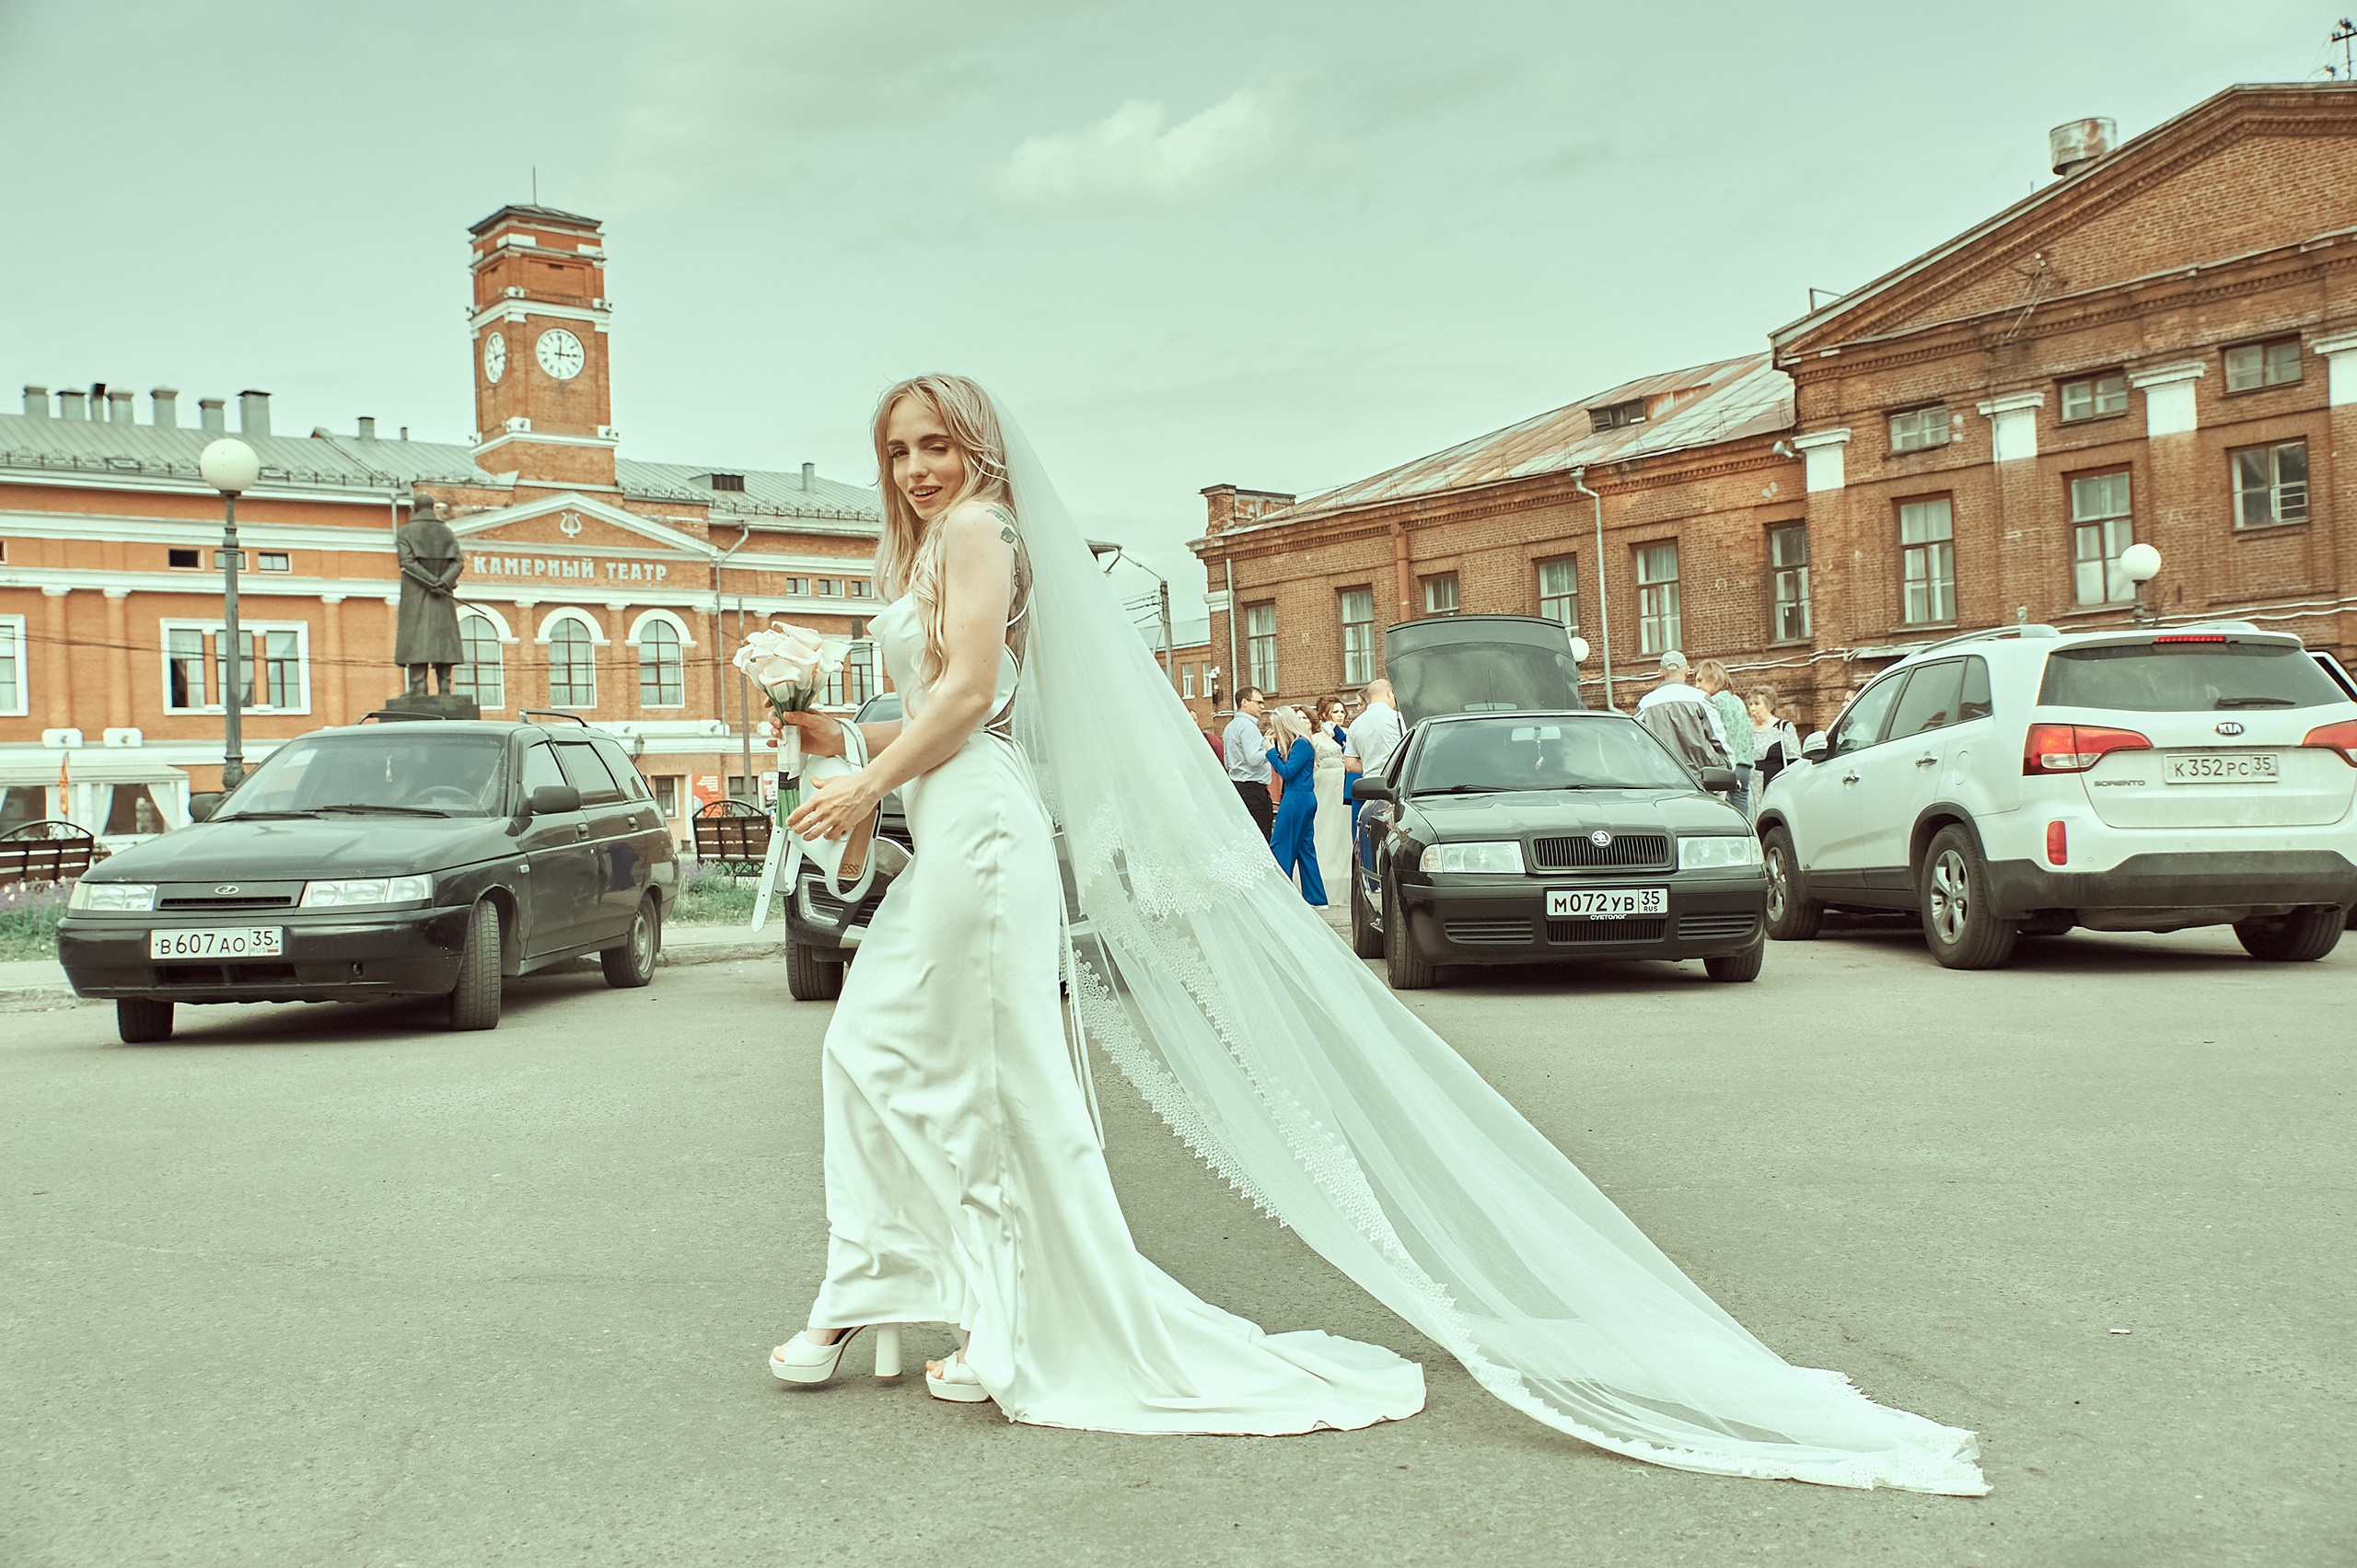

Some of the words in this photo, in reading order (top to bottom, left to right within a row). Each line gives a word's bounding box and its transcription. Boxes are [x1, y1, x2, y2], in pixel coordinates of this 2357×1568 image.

[473, 555, 595, 578] КАМЕРНЫЙ
[606, 563, 668, 581] ТЕАТР
[2218, 723, 2242, 734] KIA
[2253, 757, 2270, 771] 35
[1641, 890, 1660, 905] 35
[252, 930, 273, 947] 35
